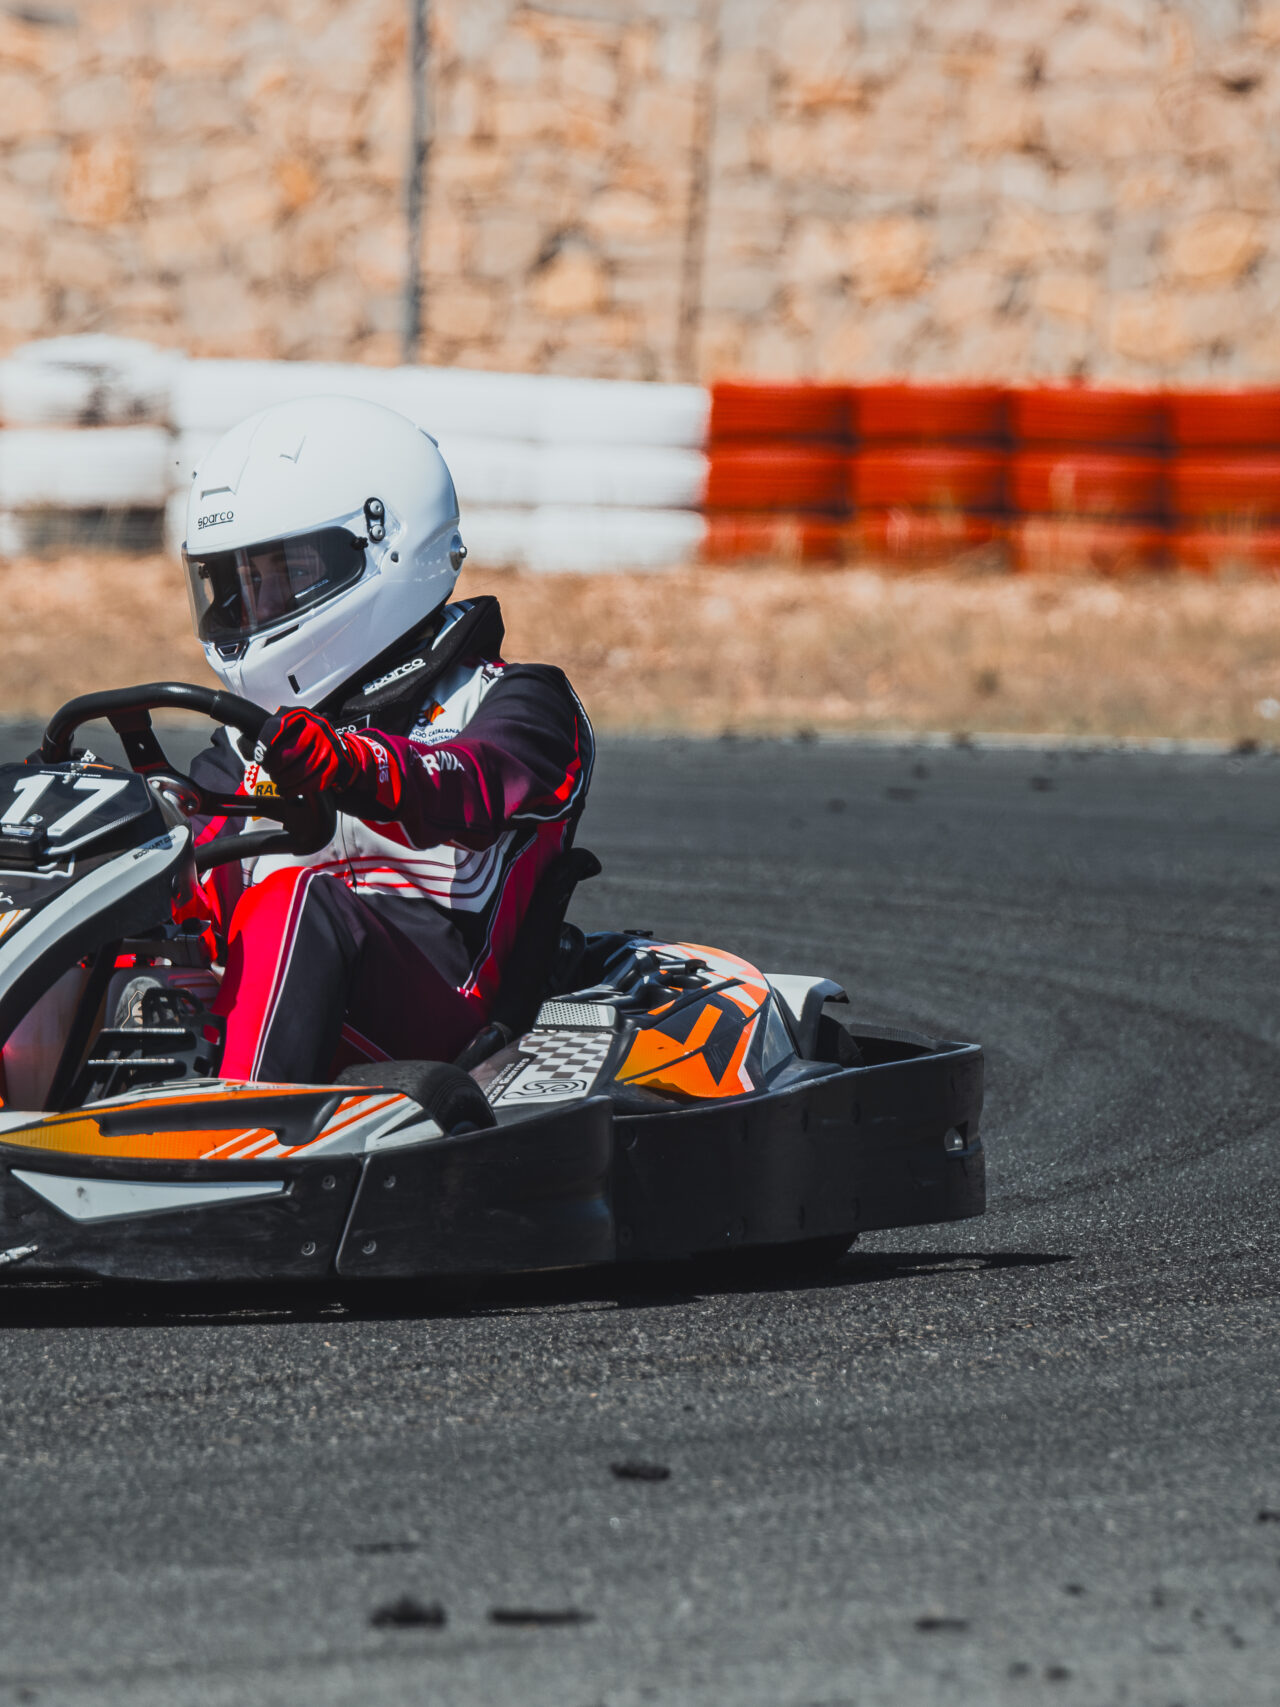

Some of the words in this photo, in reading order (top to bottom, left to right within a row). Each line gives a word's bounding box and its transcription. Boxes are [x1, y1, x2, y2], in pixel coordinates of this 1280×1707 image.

[198, 510, 234, 530] sparco
[362, 658, 426, 695] sparco
[0, 774, 130, 836] 17
